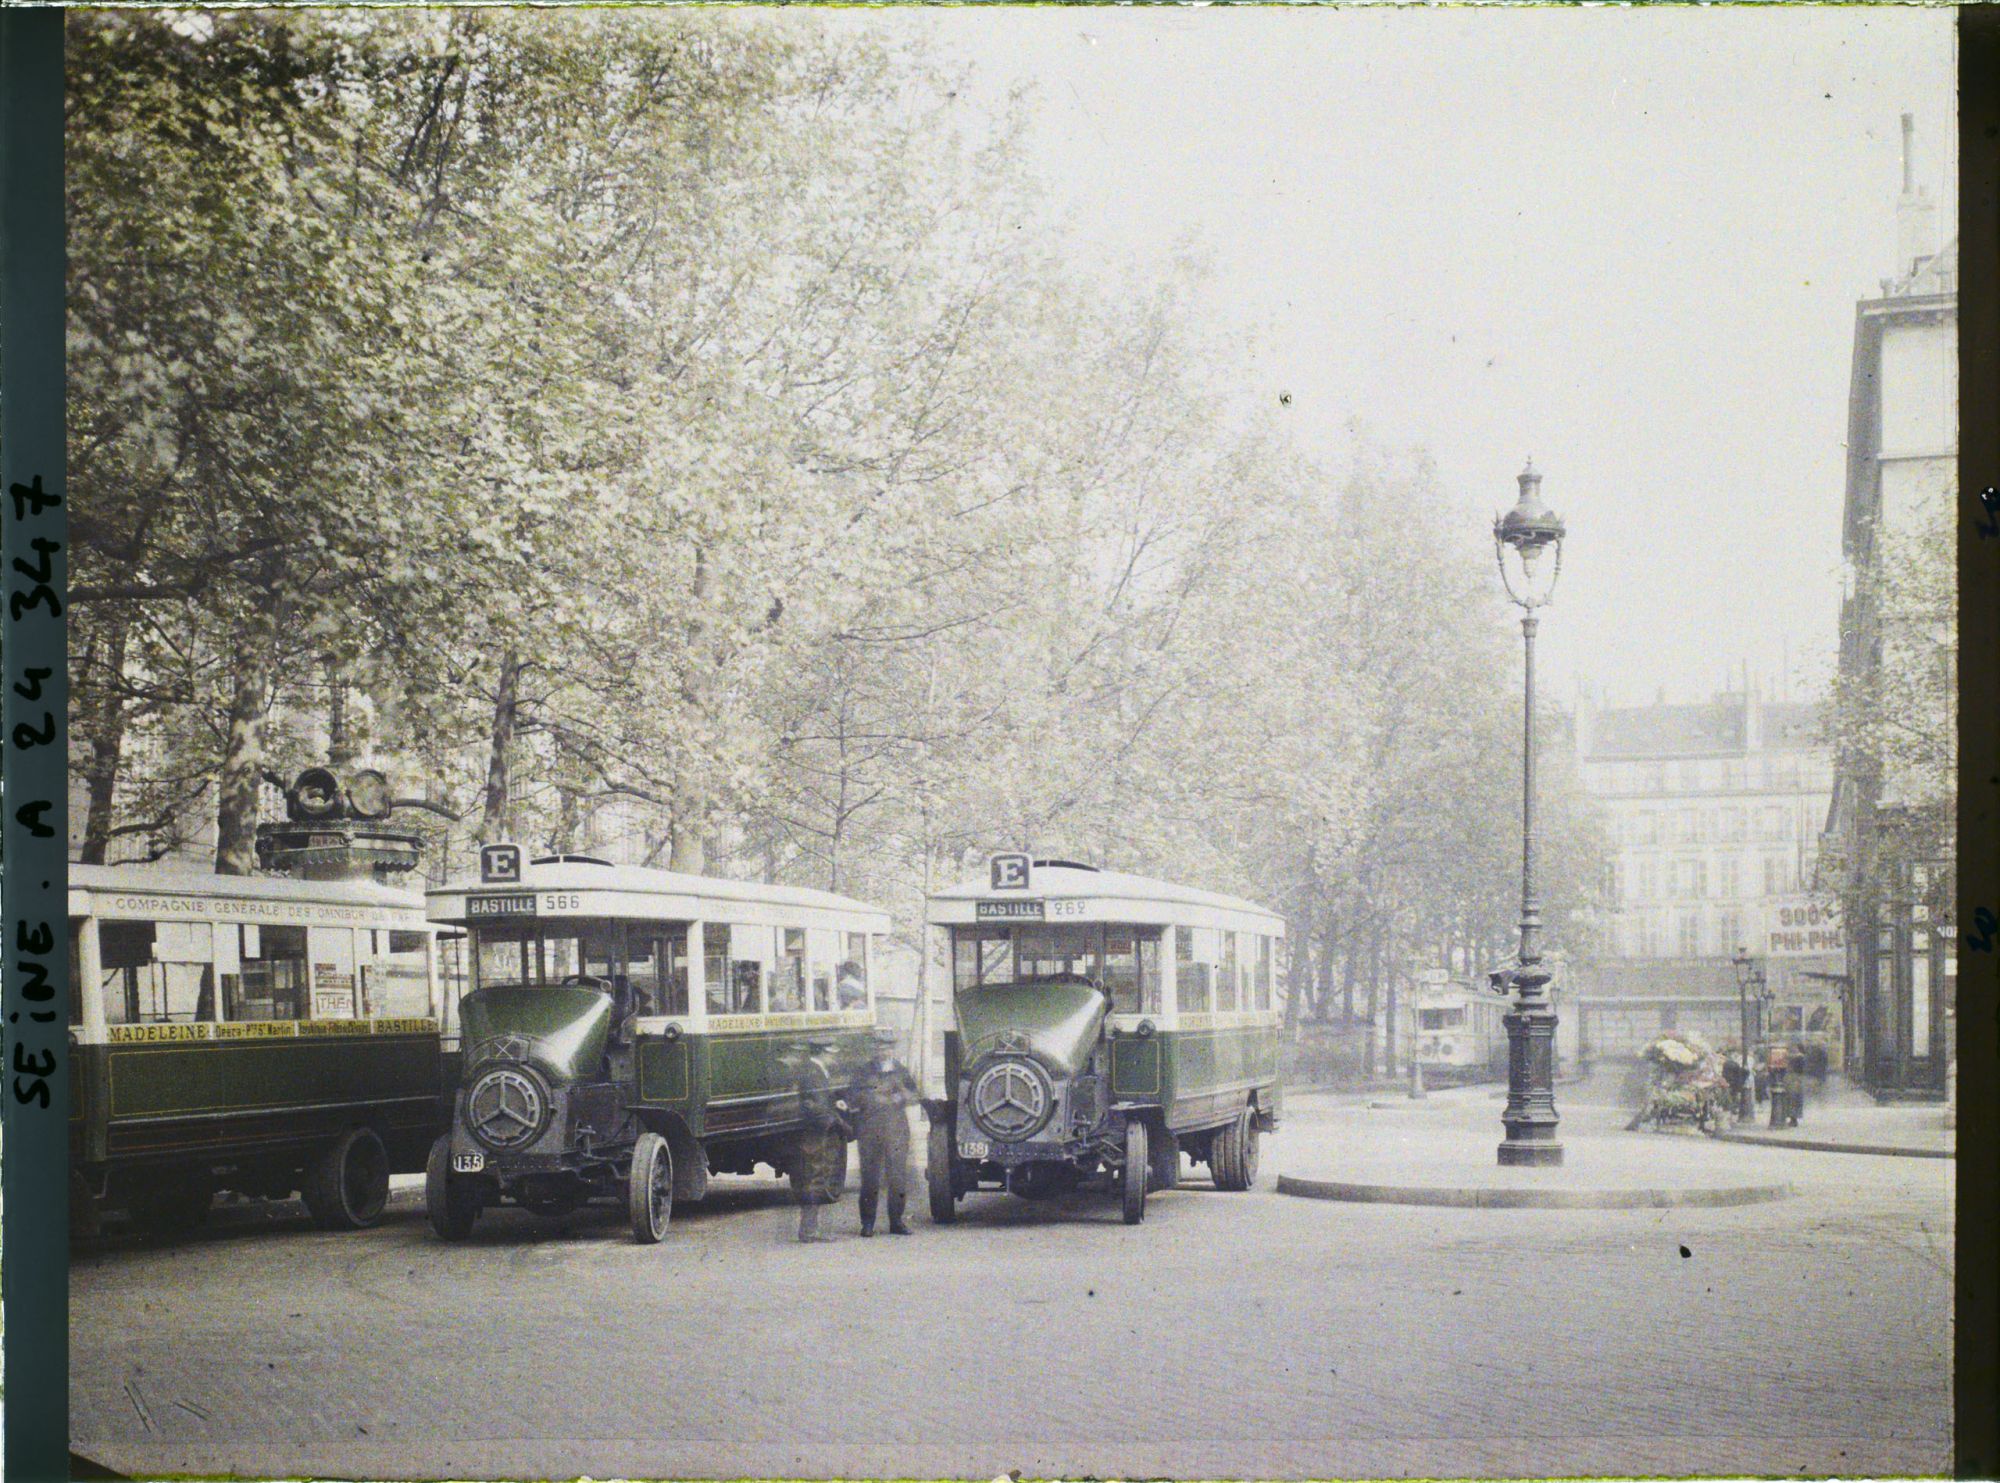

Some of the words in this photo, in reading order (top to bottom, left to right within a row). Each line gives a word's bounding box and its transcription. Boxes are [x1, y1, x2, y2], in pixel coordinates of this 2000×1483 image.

[9, 474, 62, 621] 347
[15, 800, 55, 838] A
[487, 850, 516, 878] E
[997, 860, 1025, 886] E
[115, 897, 205, 912] COMPAGNIE
[471, 898, 534, 914] BASTILLE
[546, 895, 580, 909] 566
[980, 902, 1041, 915] BASTILLE
[110, 1024, 206, 1042] MADELEINE
[377, 1019, 433, 1033] BASTILLE
